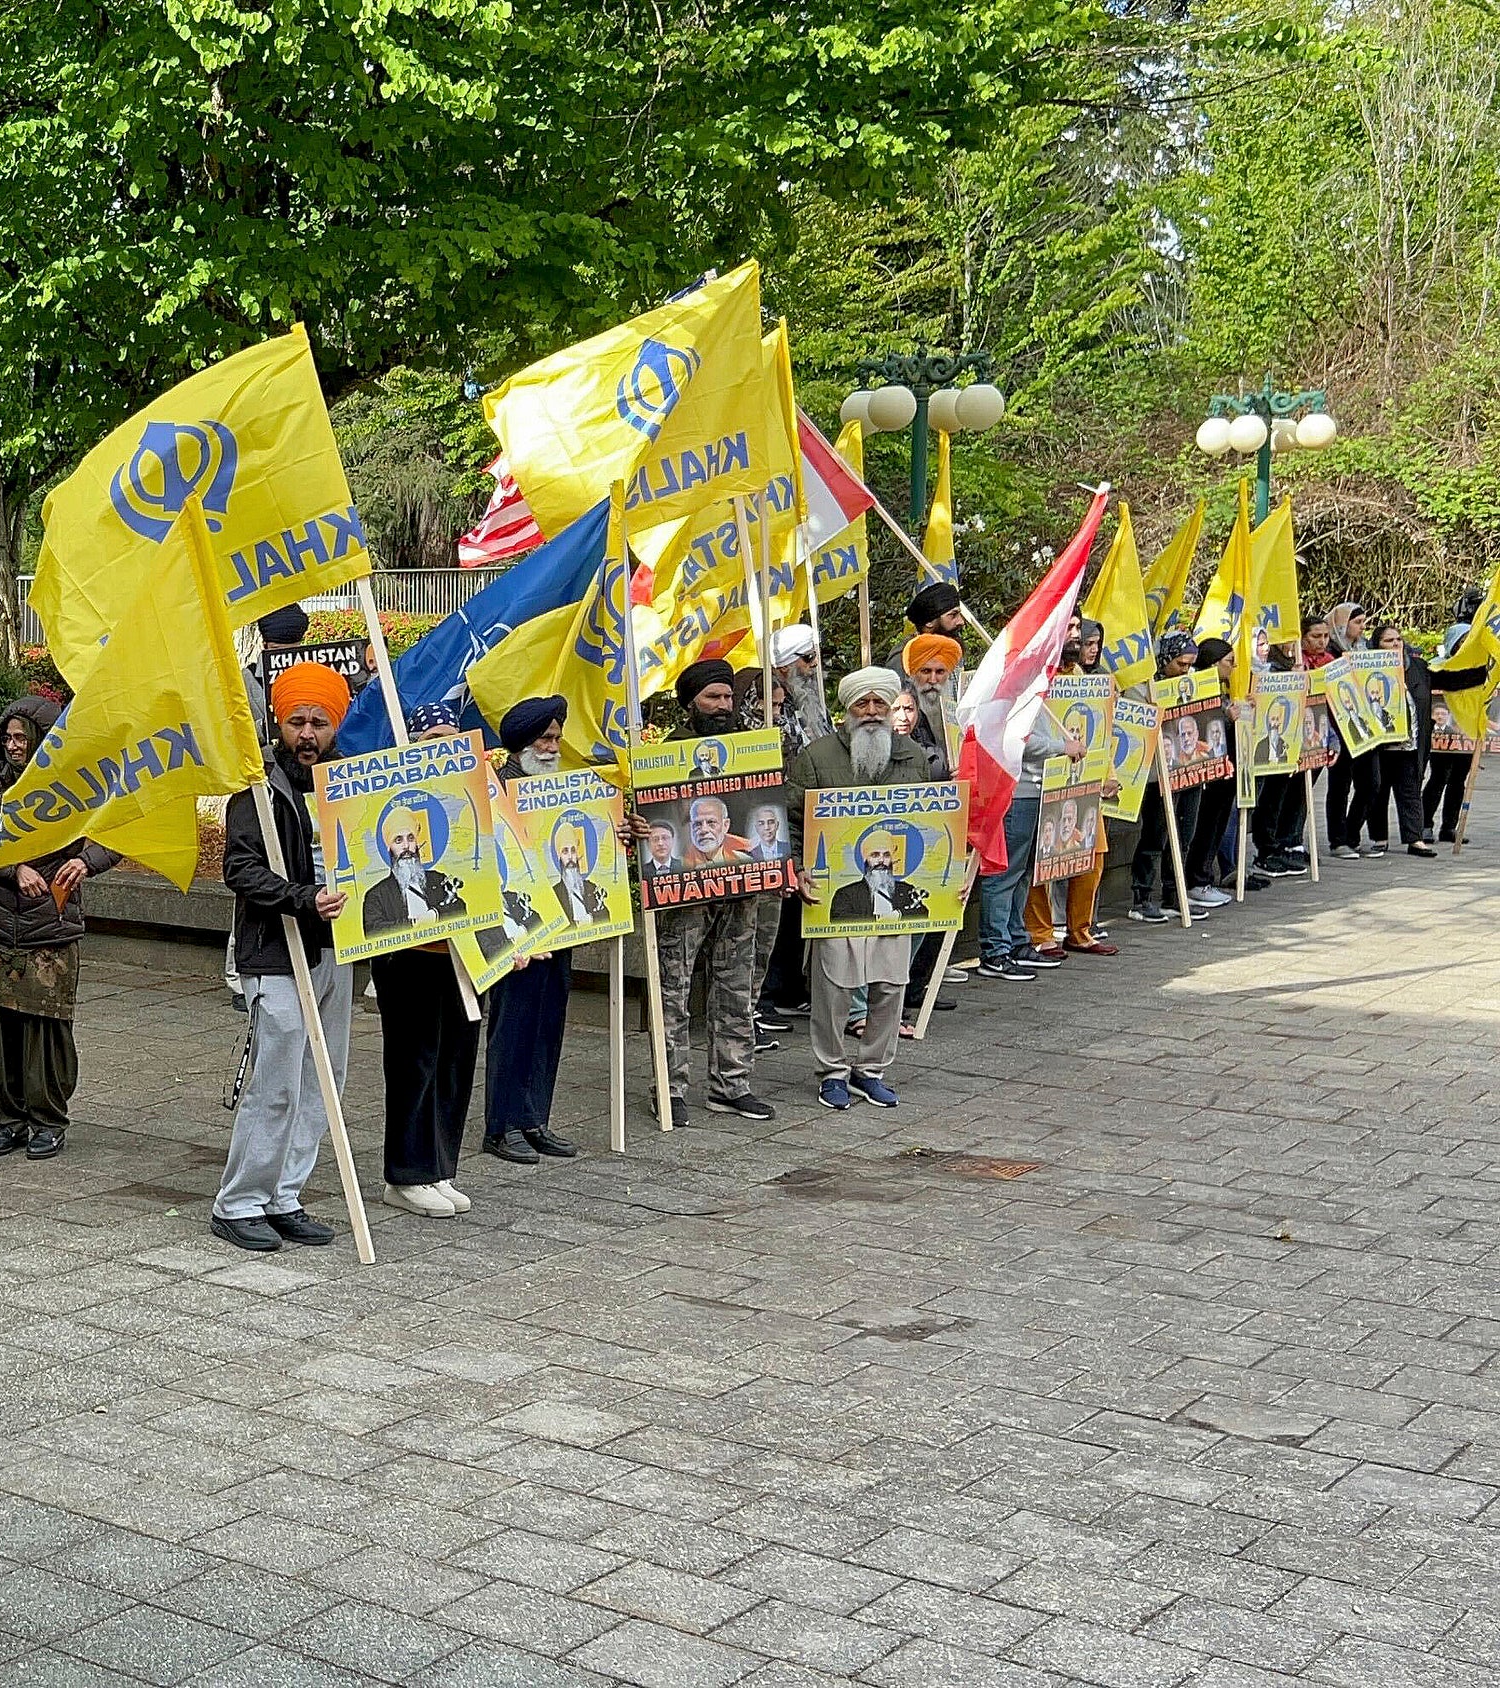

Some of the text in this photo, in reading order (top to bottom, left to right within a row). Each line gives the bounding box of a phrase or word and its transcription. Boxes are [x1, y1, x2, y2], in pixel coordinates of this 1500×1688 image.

[270, 646, 357, 669] KHALISTAN
[1114, 700, 1157, 718] ISTAN
[328, 736, 471, 783] KHALISTAN
[633, 754, 675, 771] KHALISTAN
[326, 755, 478, 802] ZINDABAAD
[518, 771, 602, 796] KHALISTA
[636, 771, 783, 805] KILLERS OF SHAHEED NIJJAR
[517, 785, 617, 812] ZINDABAAD
[819, 785, 957, 804] KHALISTAN
[815, 799, 961, 818] ZINDABAAD
[652, 874, 679, 886] FACE
[683, 870, 698, 881] OF
[701, 864, 736, 879] HINDU
[1040, 855, 1092, 882] WANTED
[653, 869, 783, 905] WANTED
[340, 943, 373, 958] SHAHEED
[472, 912, 499, 926] NIJJAR
